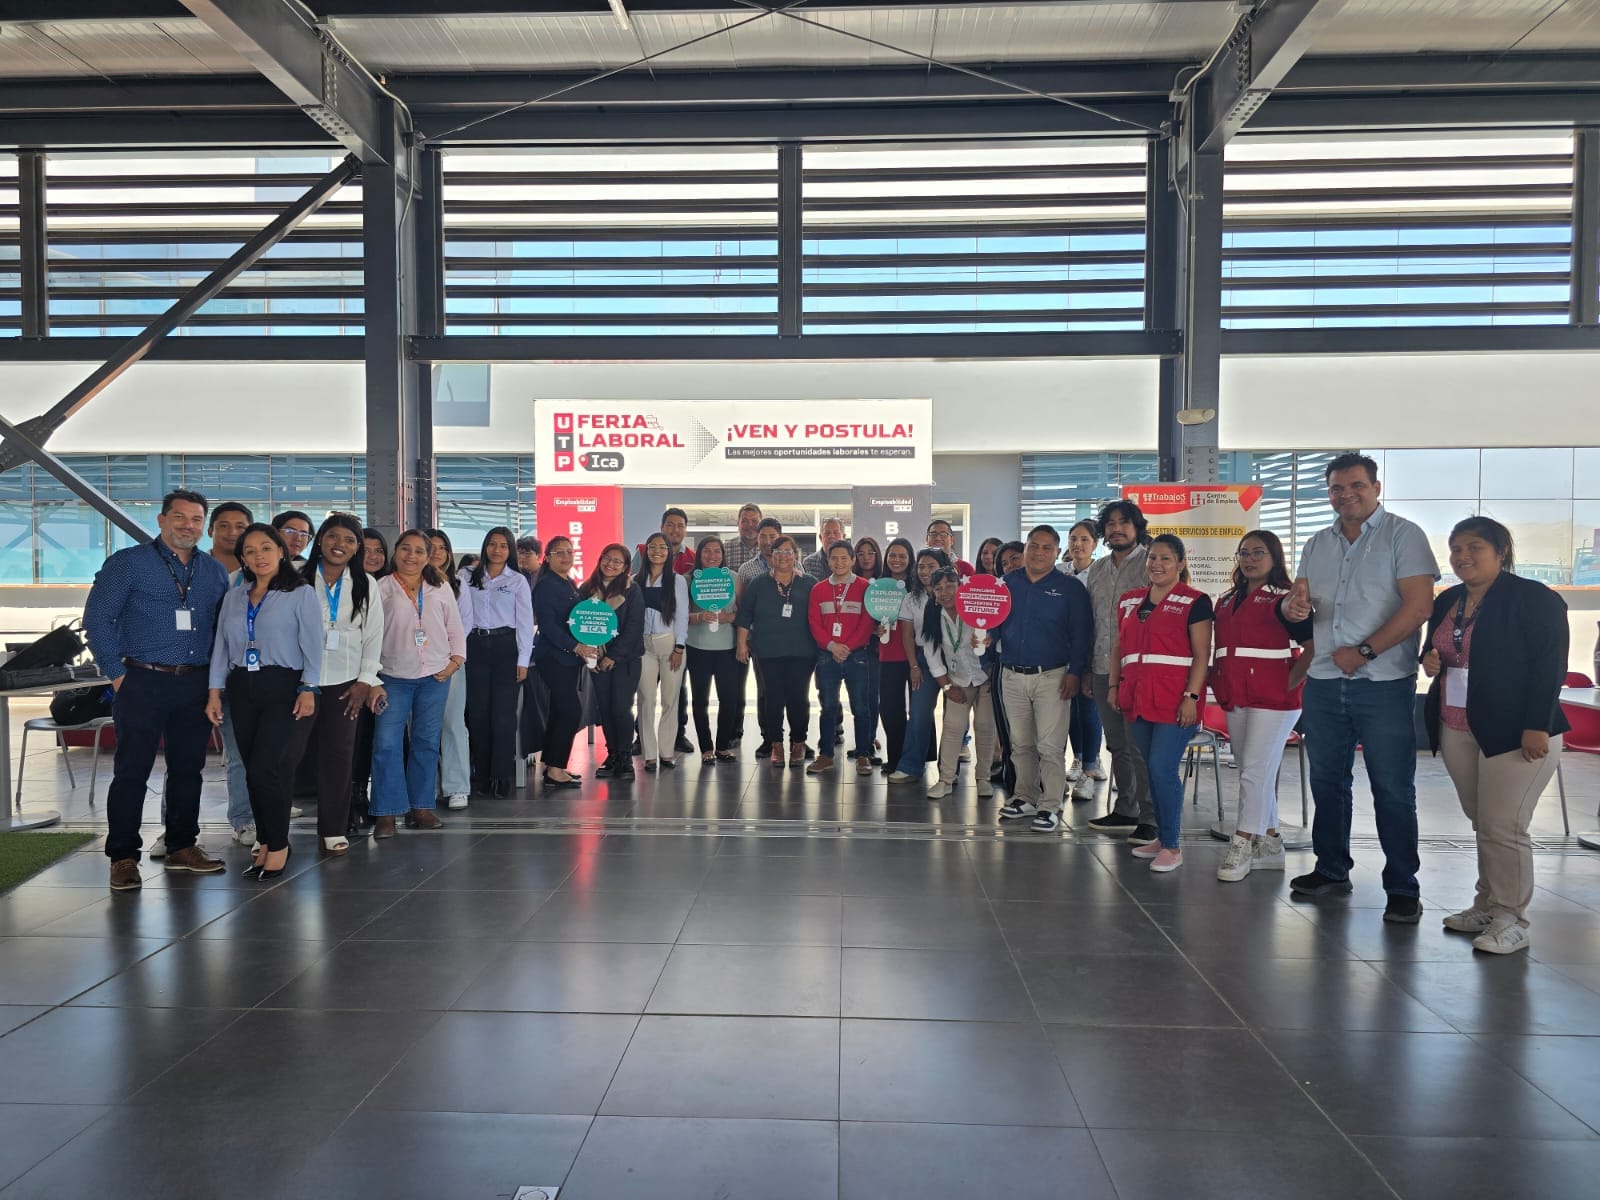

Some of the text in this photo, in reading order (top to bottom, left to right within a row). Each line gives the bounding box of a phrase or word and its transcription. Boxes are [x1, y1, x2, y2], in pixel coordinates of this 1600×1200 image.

[577, 414, 648, 429] FERIA
[727, 423, 913, 442] ¡VEN Y POSTULA!
[556, 415, 572, 469] UTP
[578, 433, 685, 448] LABORAL
[727, 447, 913, 457] Las mejores oportunidades laborales te esperan.
[591, 454, 619, 468] Ica
[1179, 527, 1210, 536] SERVICIOS
[1211, 527, 1218, 536] DE
